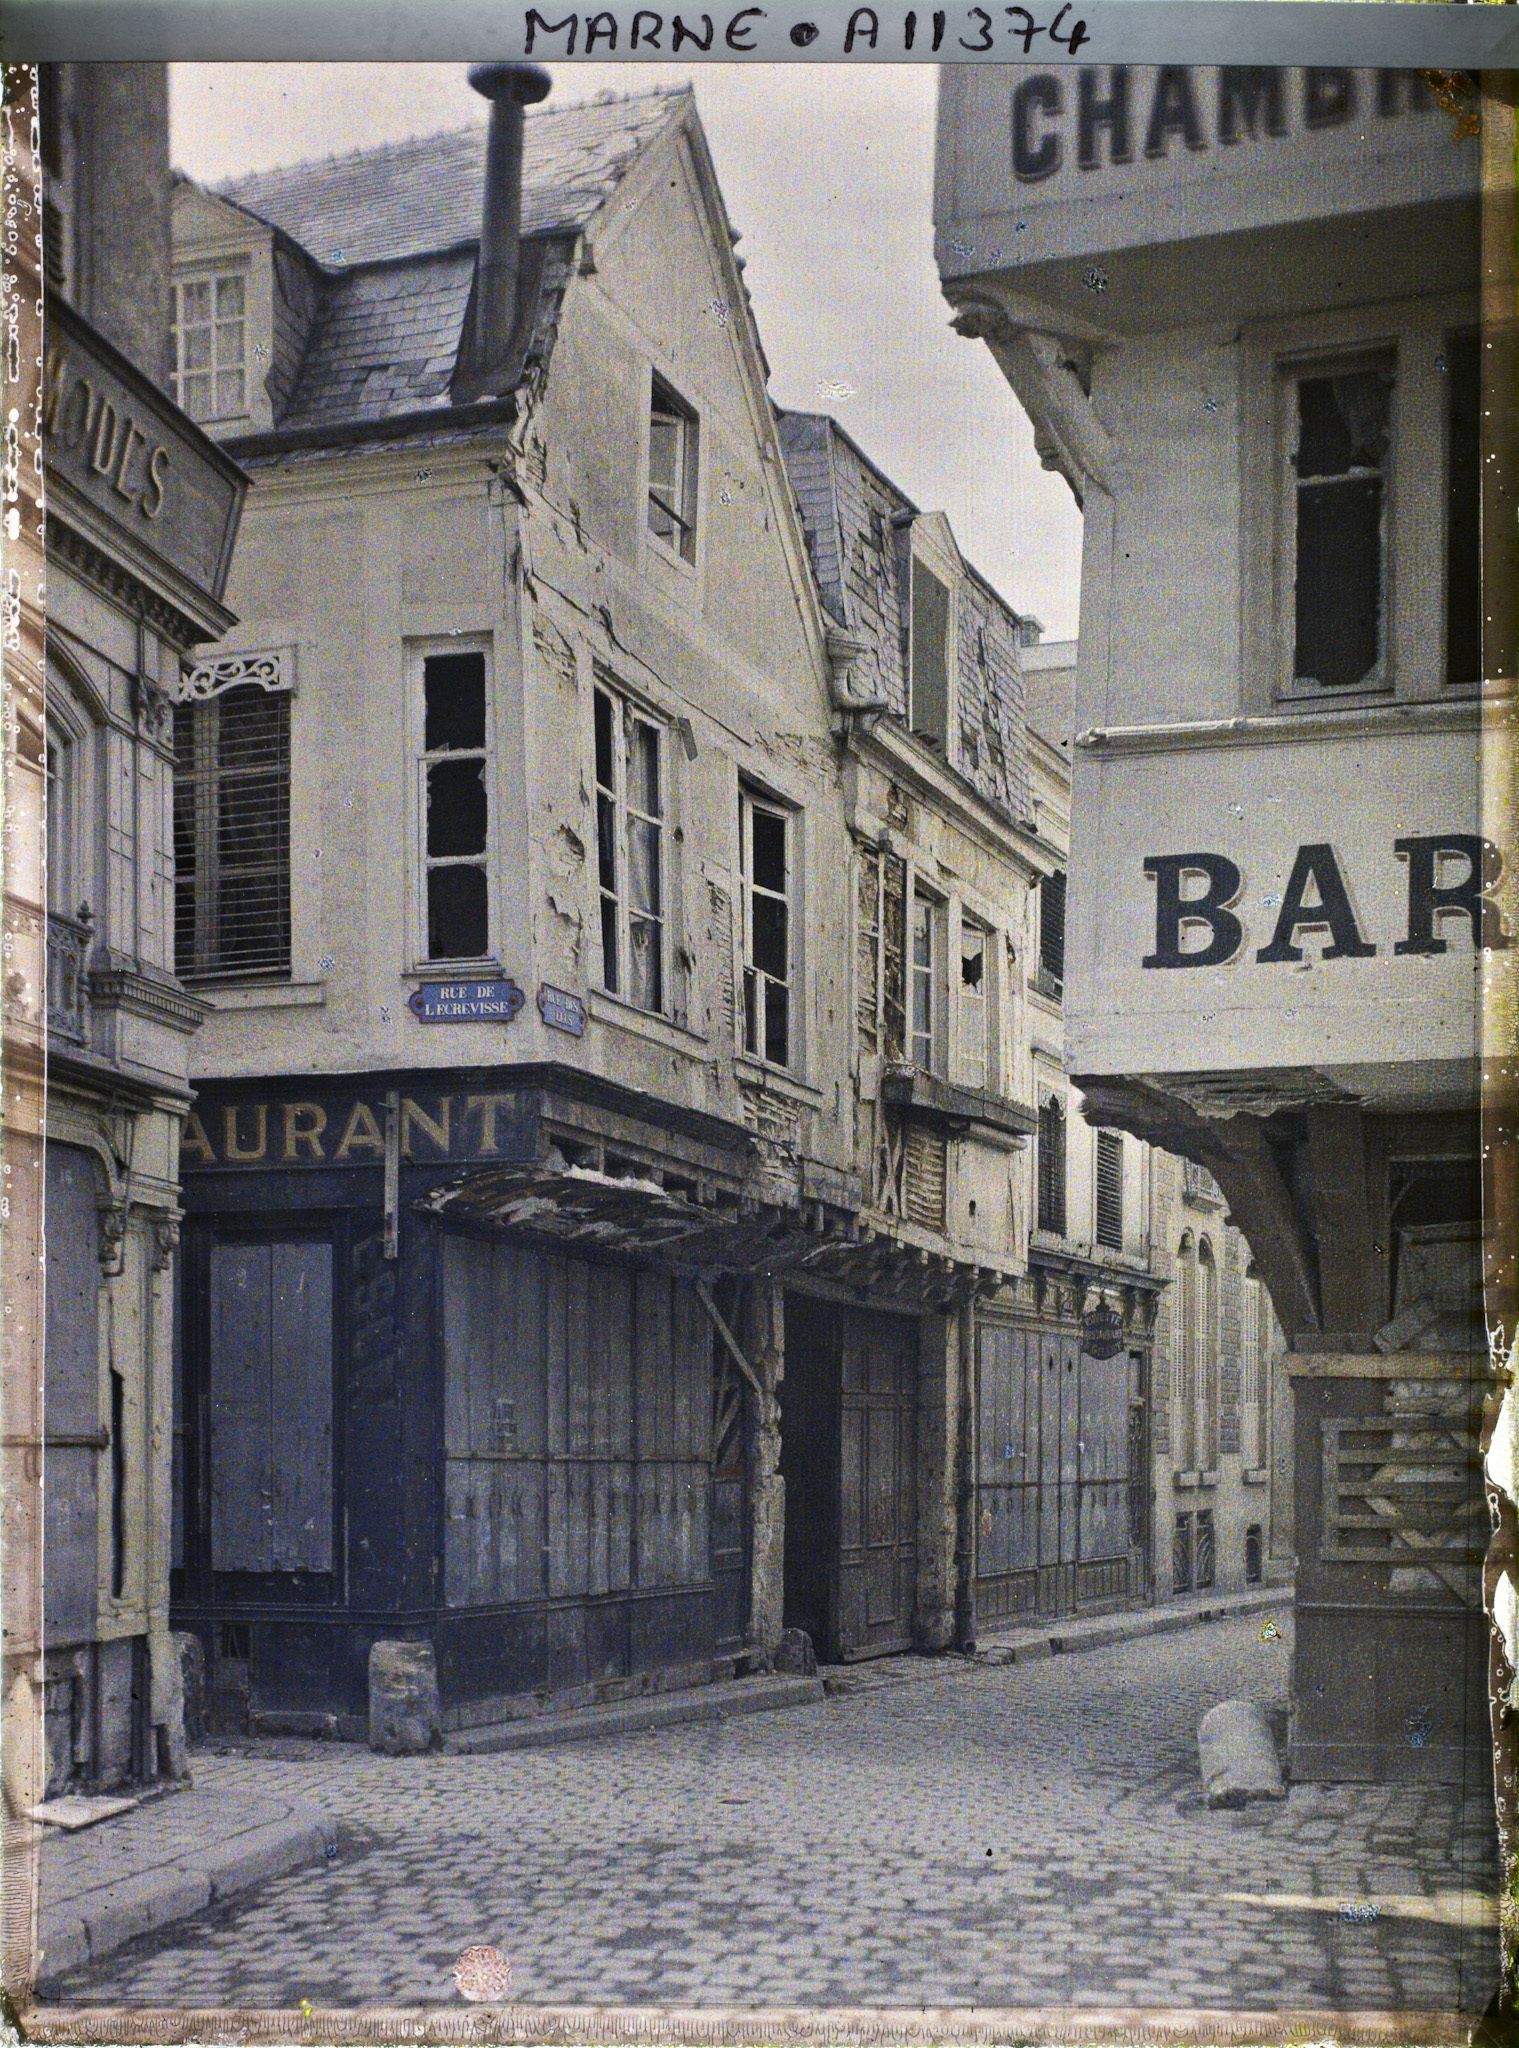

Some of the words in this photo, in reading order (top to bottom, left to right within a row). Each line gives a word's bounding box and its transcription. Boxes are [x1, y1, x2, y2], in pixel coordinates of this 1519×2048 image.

[1142, 834, 1509, 970] BAR
[440, 986, 468, 999] RUE
[477, 986, 495, 998] DE
